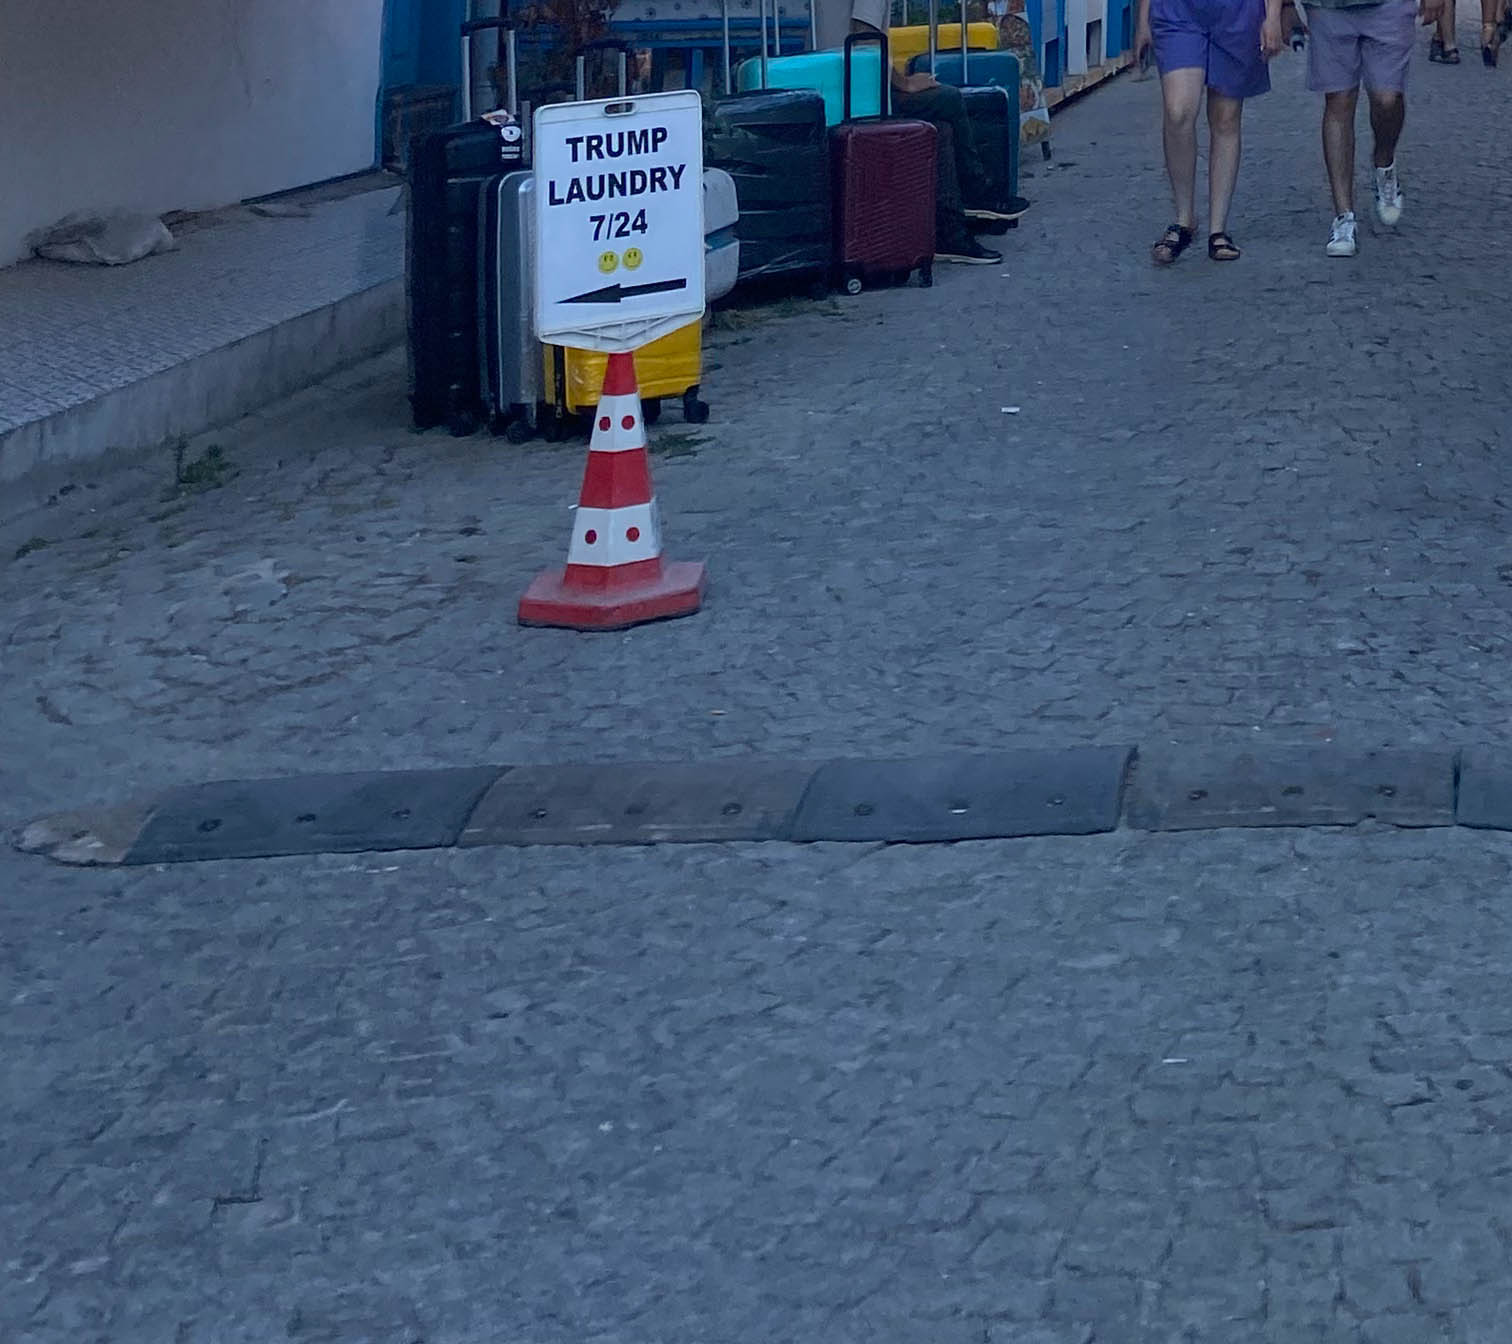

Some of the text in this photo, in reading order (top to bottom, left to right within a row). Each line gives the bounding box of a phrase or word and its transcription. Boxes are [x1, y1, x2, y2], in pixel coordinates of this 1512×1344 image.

[566, 127, 668, 162] TRUMP
[548, 164, 686, 206] LAUNDRY
[590, 209, 648, 241] 7/24
